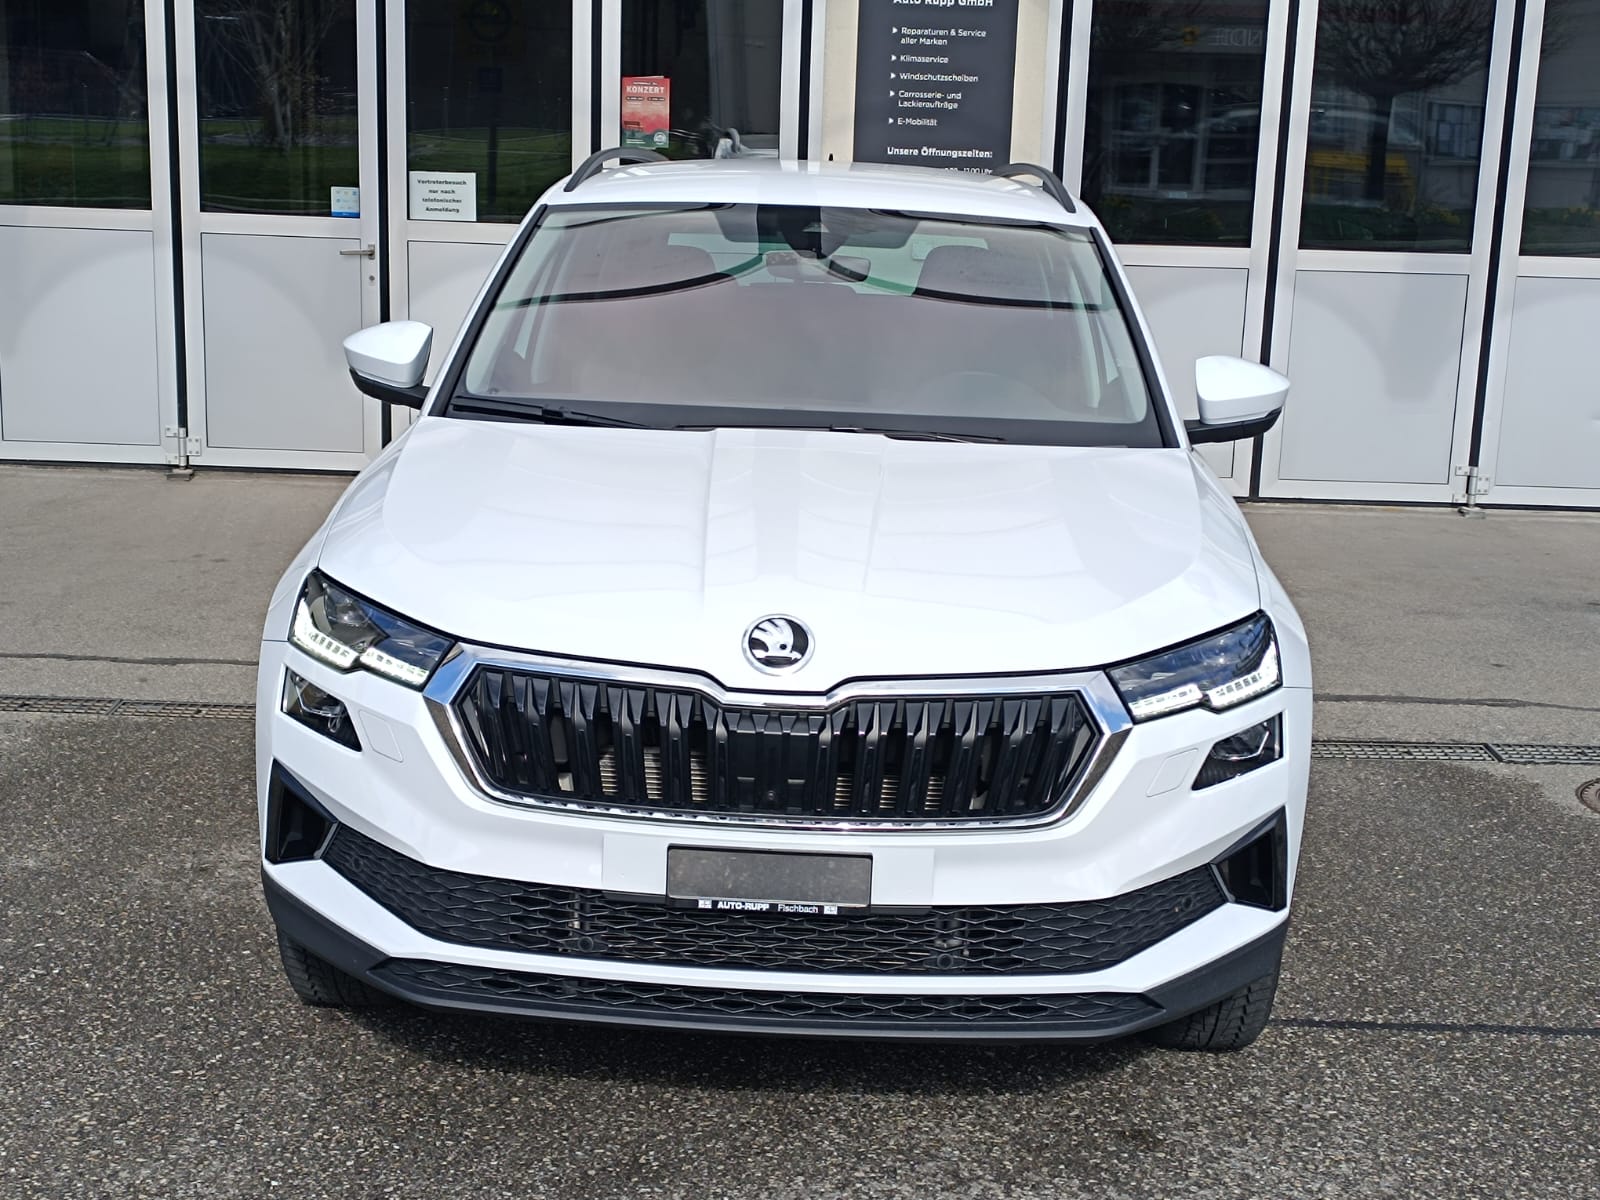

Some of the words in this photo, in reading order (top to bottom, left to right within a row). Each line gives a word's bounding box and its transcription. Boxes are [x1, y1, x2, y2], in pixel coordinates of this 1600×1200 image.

[901, 27, 949, 36] Reparaturen
[958, 29, 987, 38] Service
[919, 37, 948, 46] Marken
[900, 55, 949, 64] Klimaservice
[899, 72, 979, 82] Windschutzscheiben
[626, 85, 665, 93] KONZERT
[898, 90, 945, 99] Carrosserie-
[946, 92, 962, 100] und
[898, 100, 958, 110] Lackieraufträge
[897, 117, 938, 126] E-Mobilität
[887, 146, 919, 156] Unsere
[920, 146, 993, 158] Öffnungszeiten:
[425, 206, 460, 214] Anmeldung
[717, 901, 770, 911] AUTO-RUPP
[777, 903, 819, 914] Fischbach
